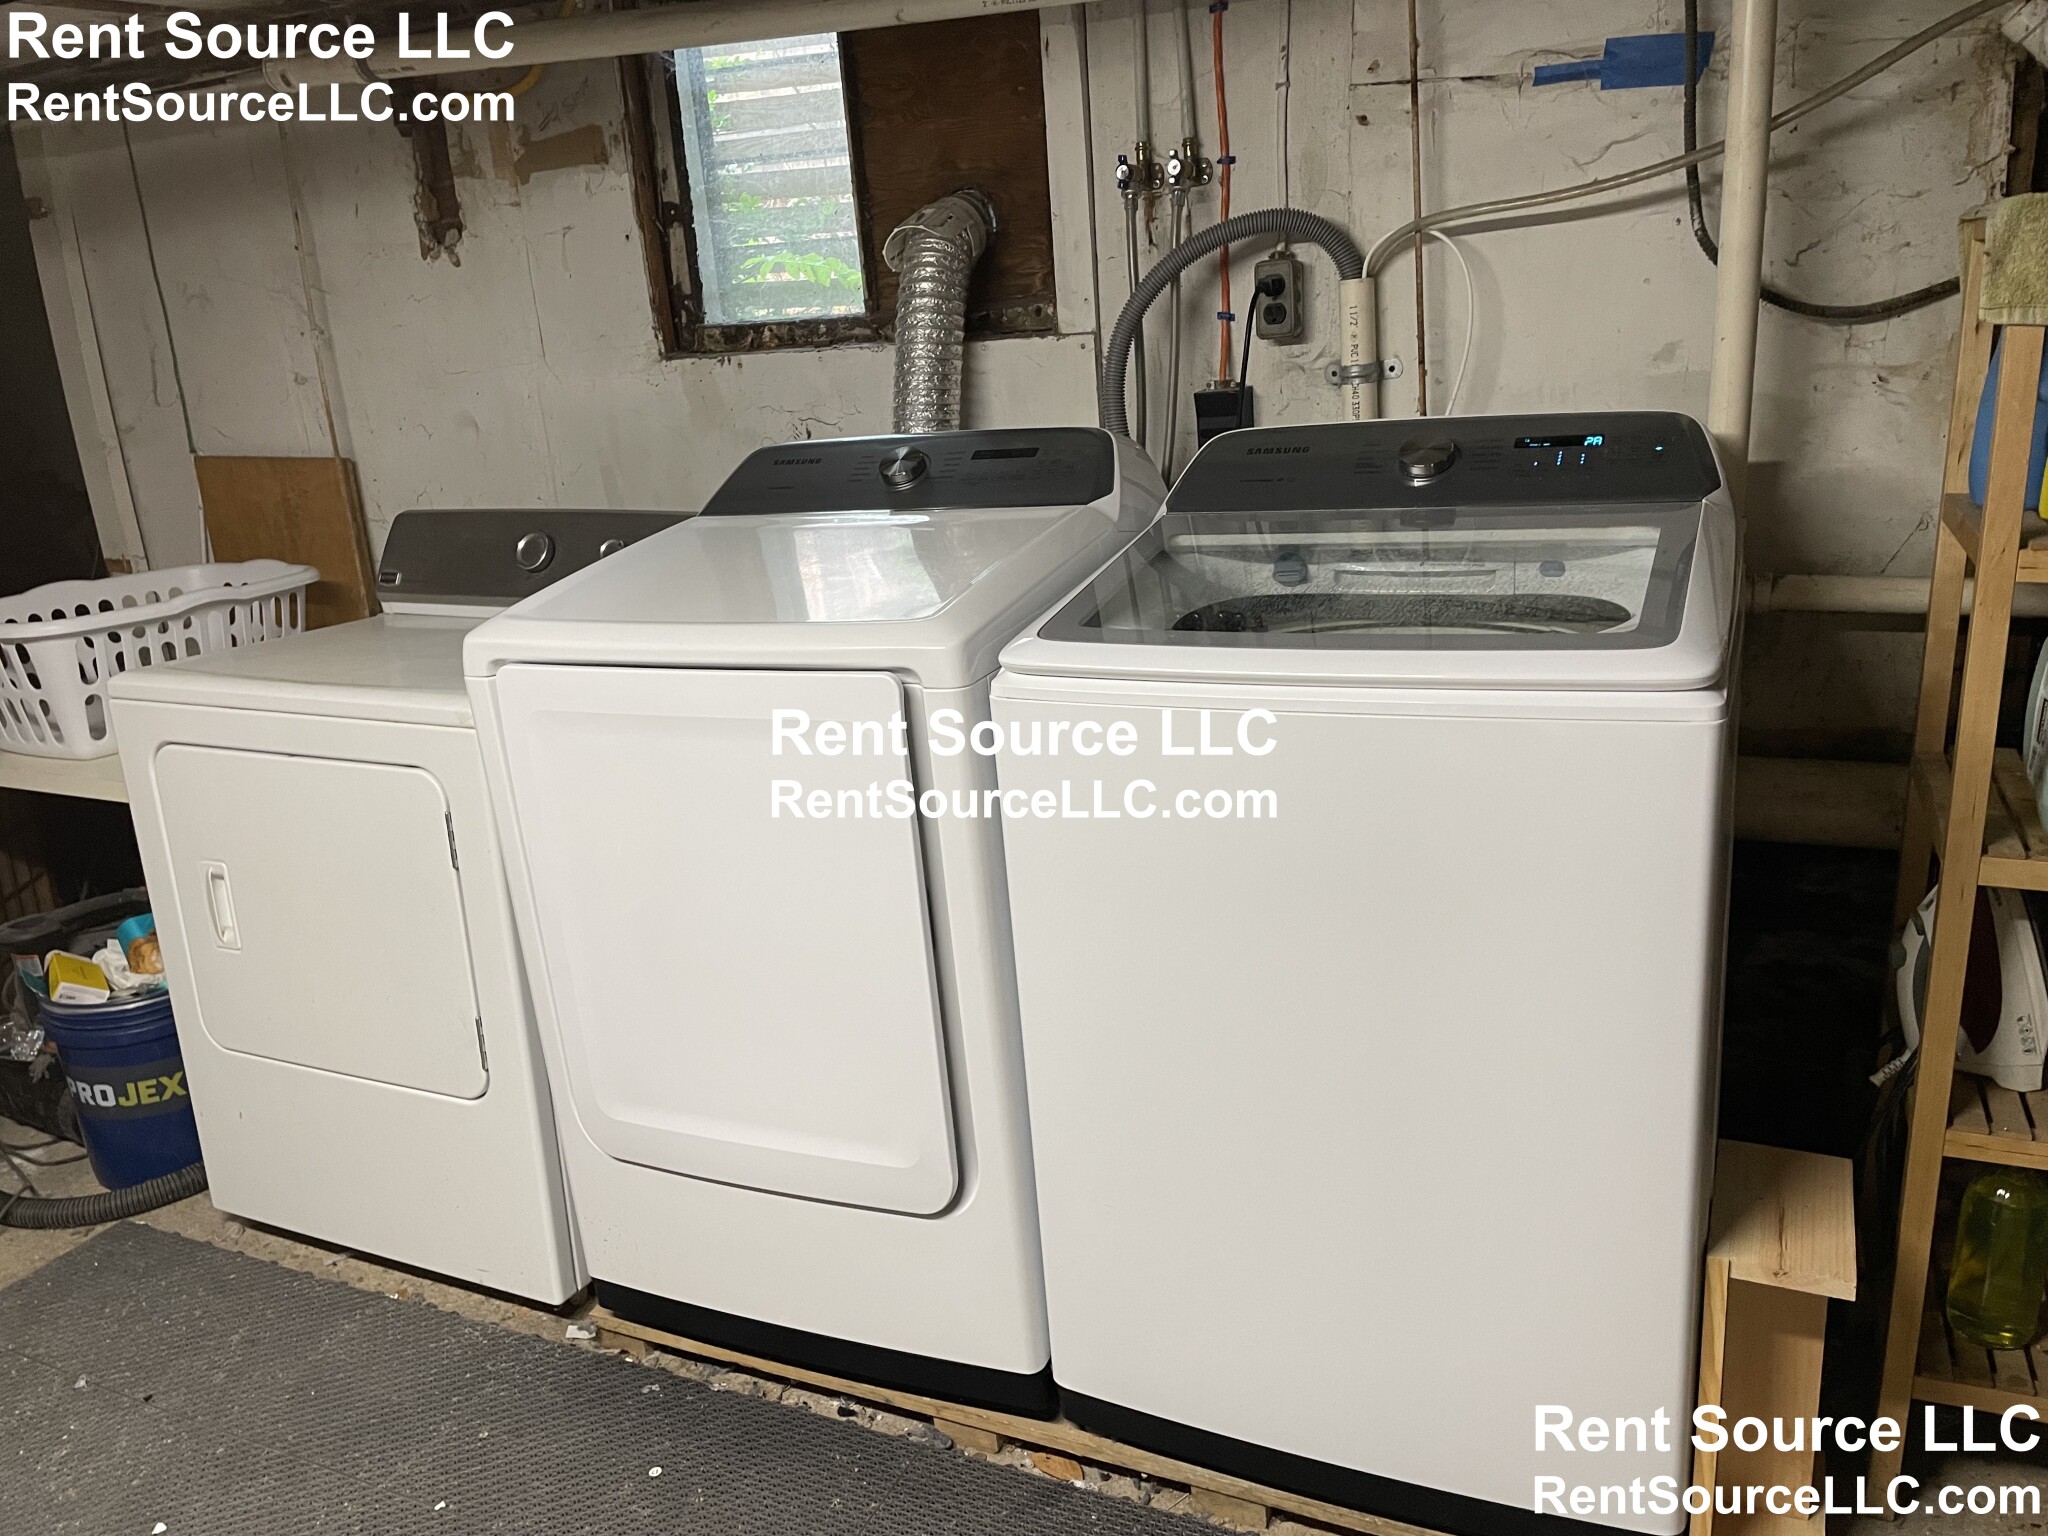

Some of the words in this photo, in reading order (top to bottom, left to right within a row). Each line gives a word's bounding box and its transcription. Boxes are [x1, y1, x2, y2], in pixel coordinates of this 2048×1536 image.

[1351, 382, 1360, 399] CH40
[1246, 446, 1310, 456] SAMSUNG
[773, 457, 822, 467] SAMSUNG
[66, 1071, 188, 1108] PROJEX
